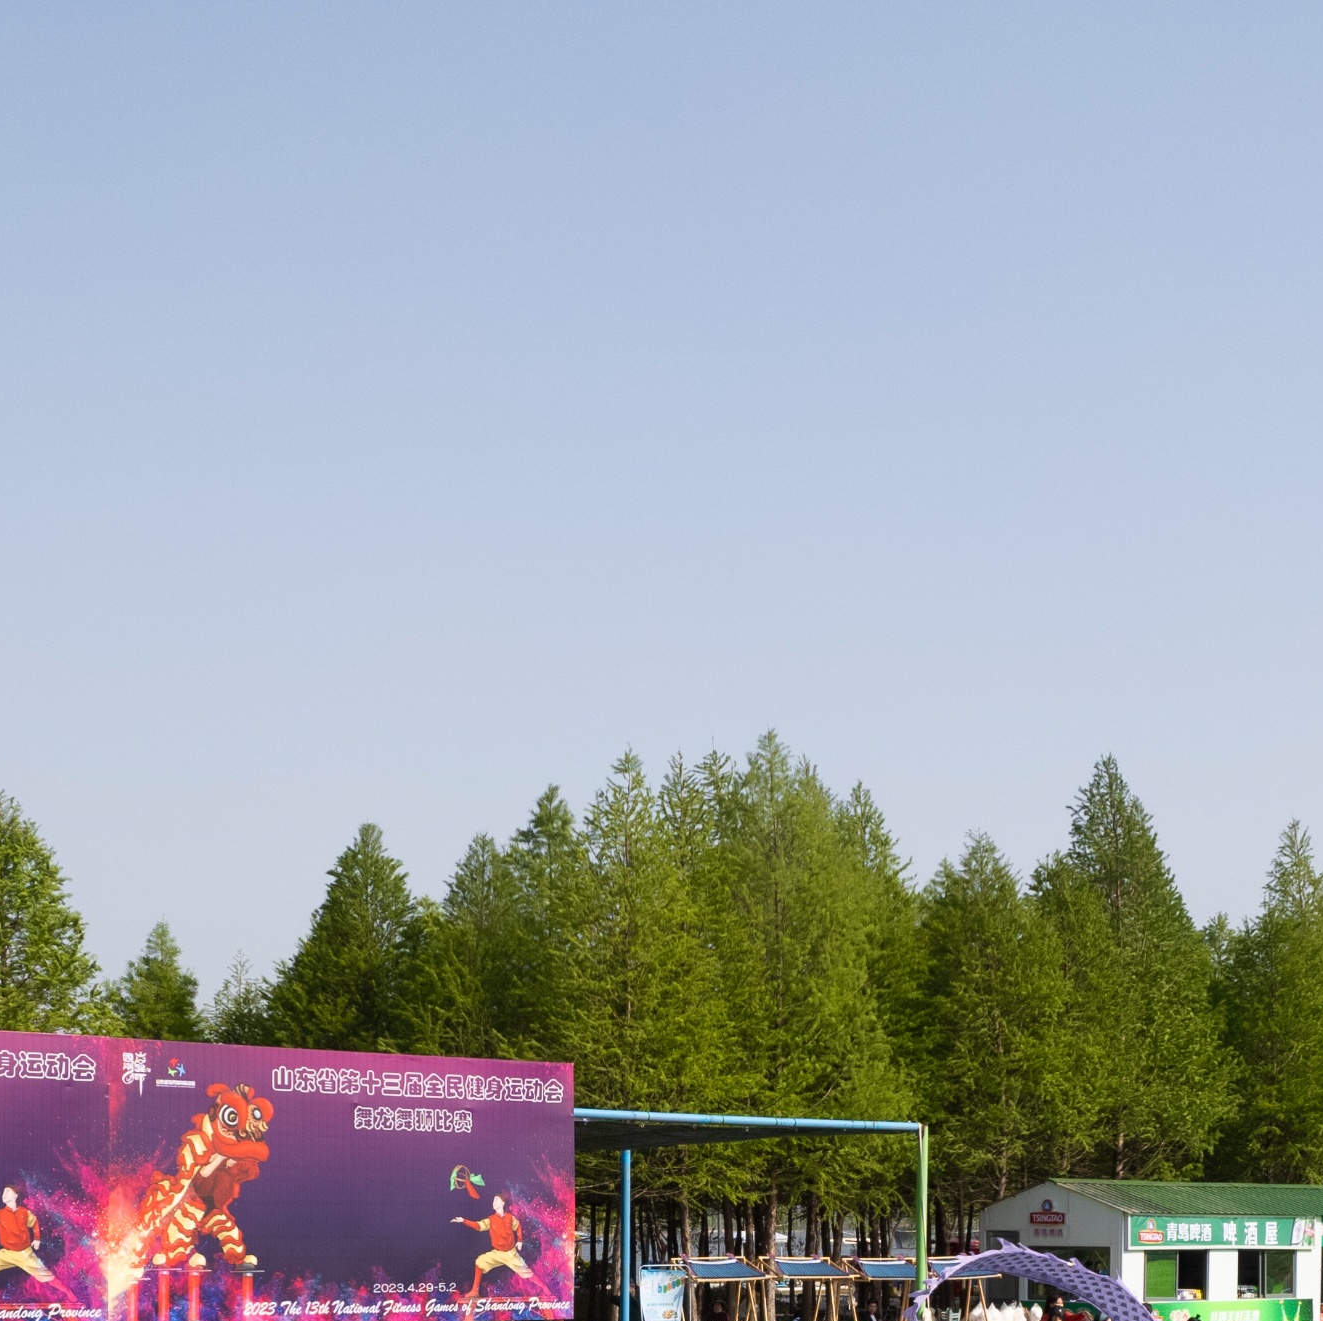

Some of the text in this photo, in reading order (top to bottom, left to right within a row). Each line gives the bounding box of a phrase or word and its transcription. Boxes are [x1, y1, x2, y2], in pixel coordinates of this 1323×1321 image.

[272, 1066, 564, 1103] 山东省第十三届全民健身运动会
[354, 1106, 473, 1133] 舞龙舞狮比赛
[1031, 1213, 1064, 1223] TSINGTAO
[372, 1283, 457, 1293] 2023.4.29-5.2
[47, 1303, 102, 1320] Province
[243, 1296, 570, 1317] 2023 The 13th National Fitness Games of Shandong Province
